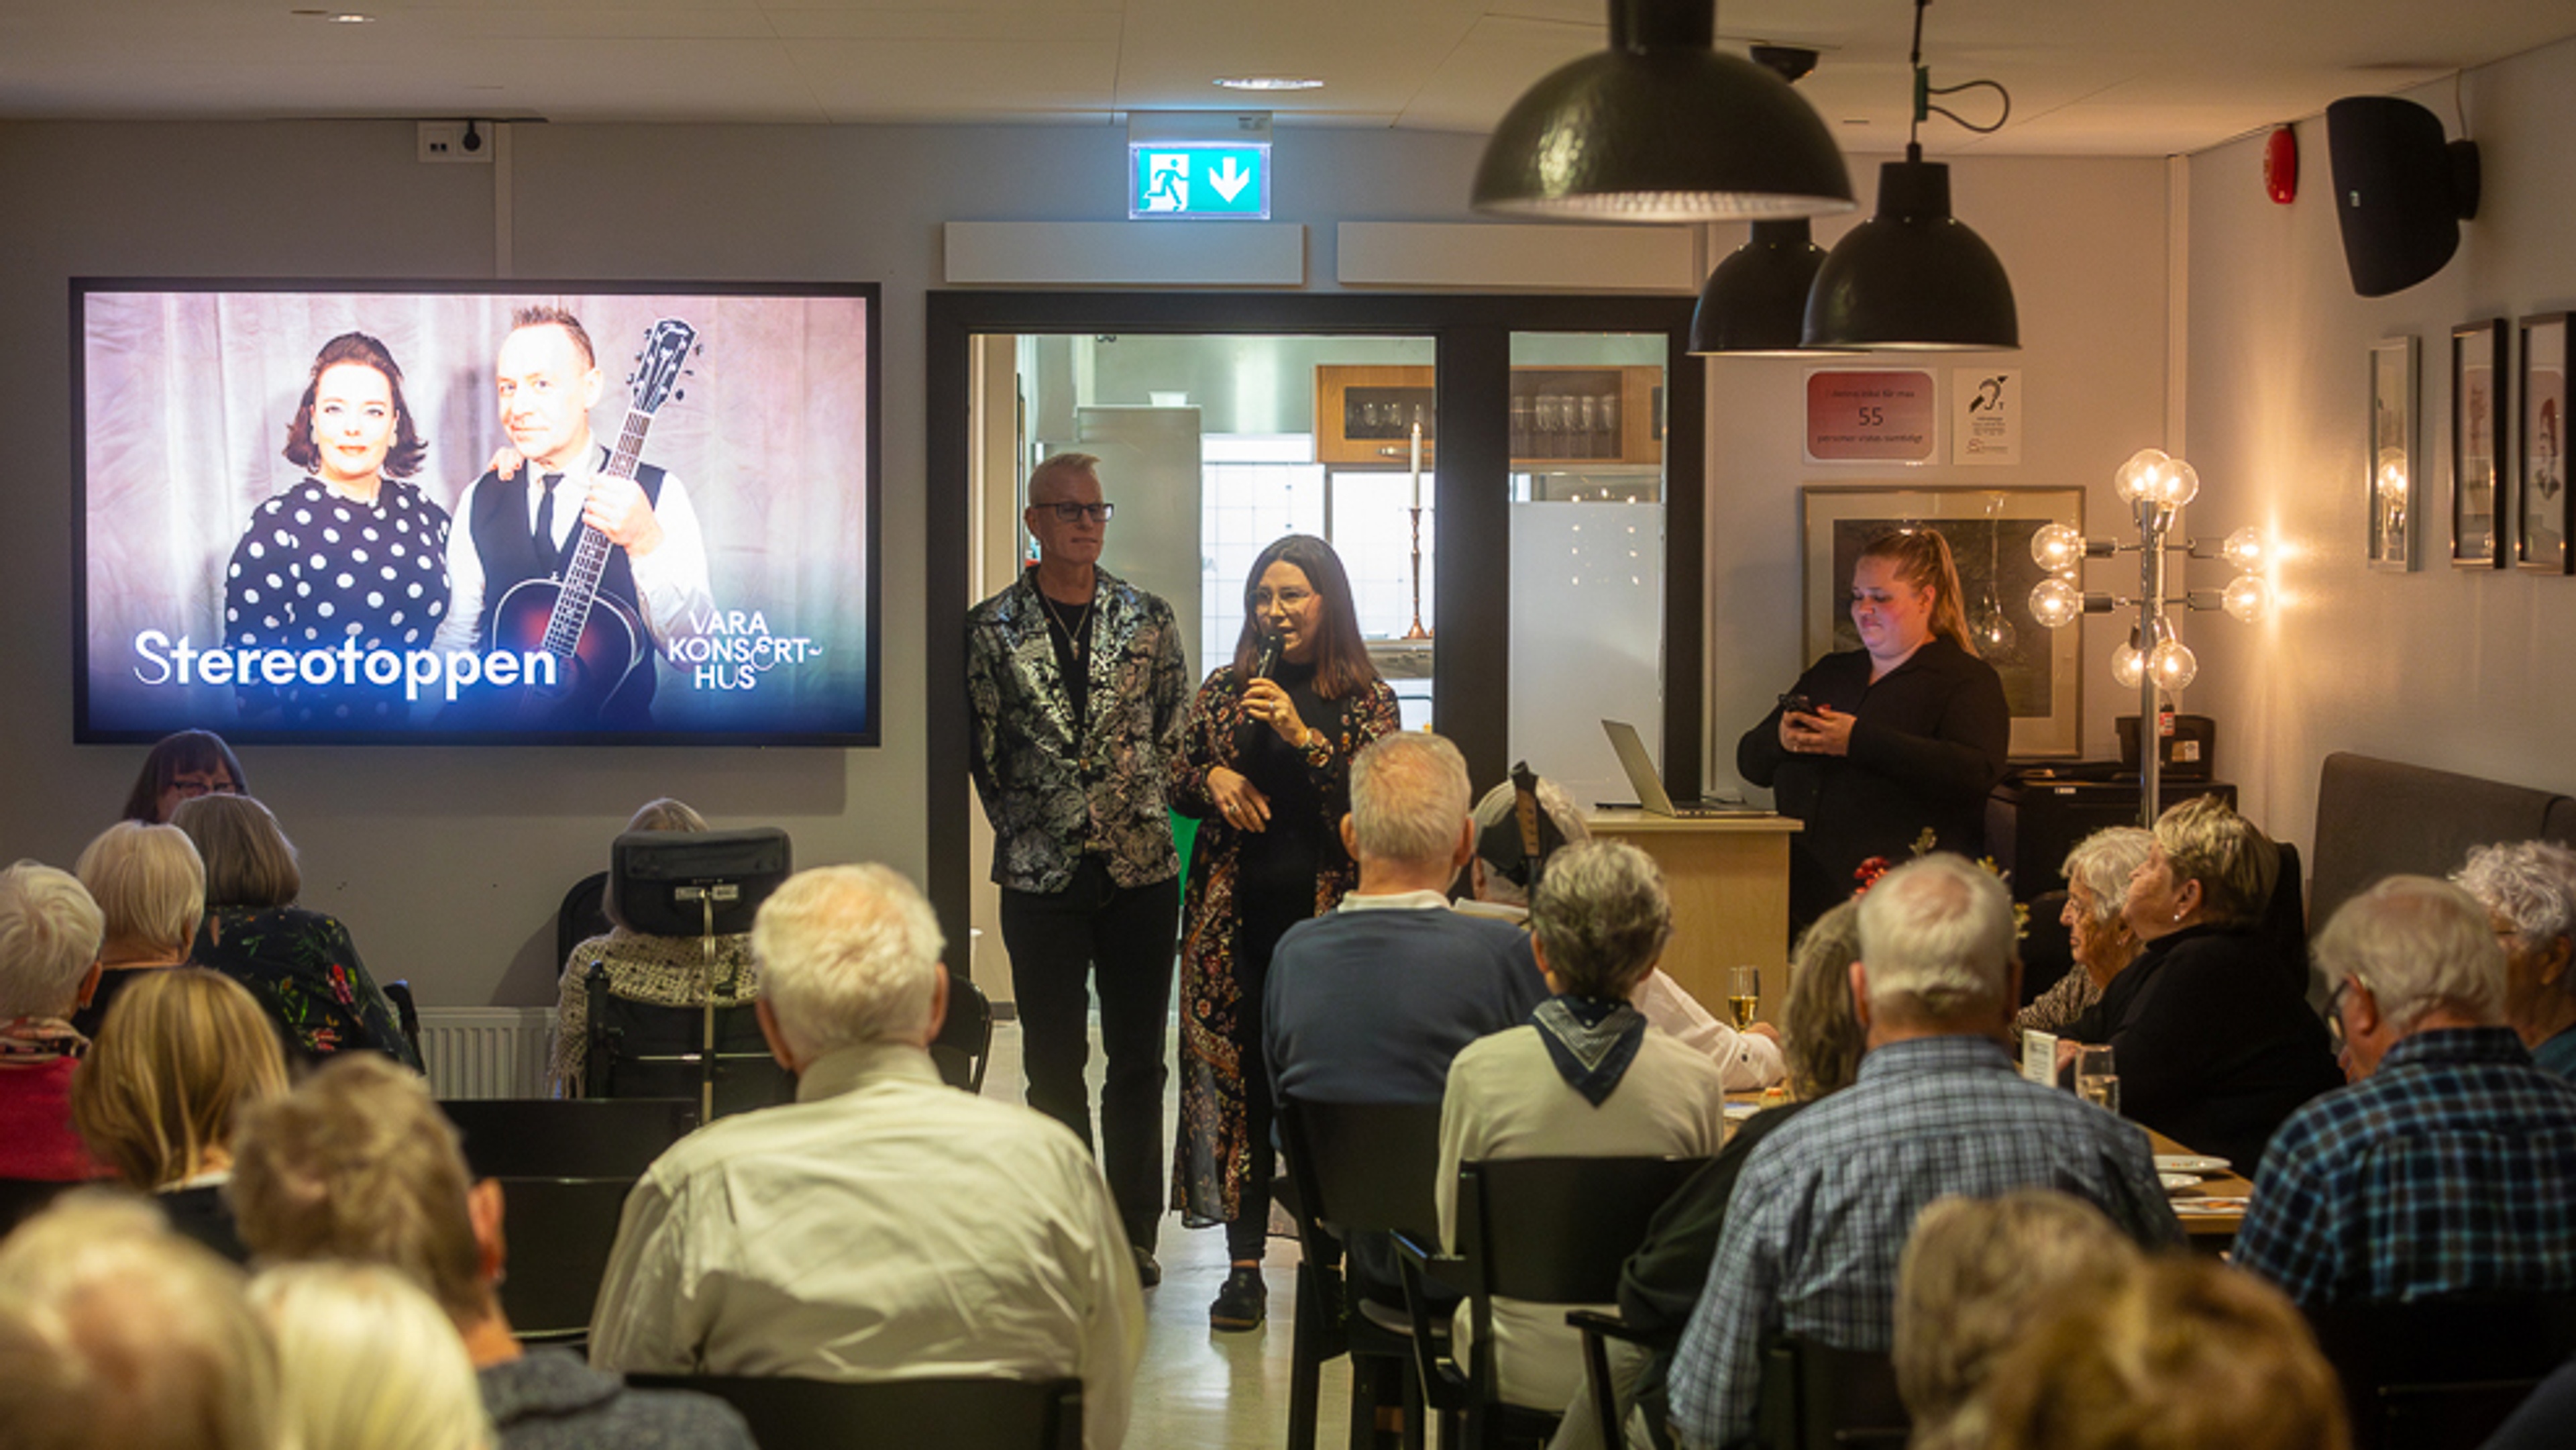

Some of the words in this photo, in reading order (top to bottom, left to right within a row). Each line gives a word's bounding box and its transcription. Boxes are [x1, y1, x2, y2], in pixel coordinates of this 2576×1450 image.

[1858, 407, 1884, 426] 55
[688, 610, 769, 635] VARA
[133, 630, 556, 701] Stereotoppen
[695, 664, 756, 690] HUS
